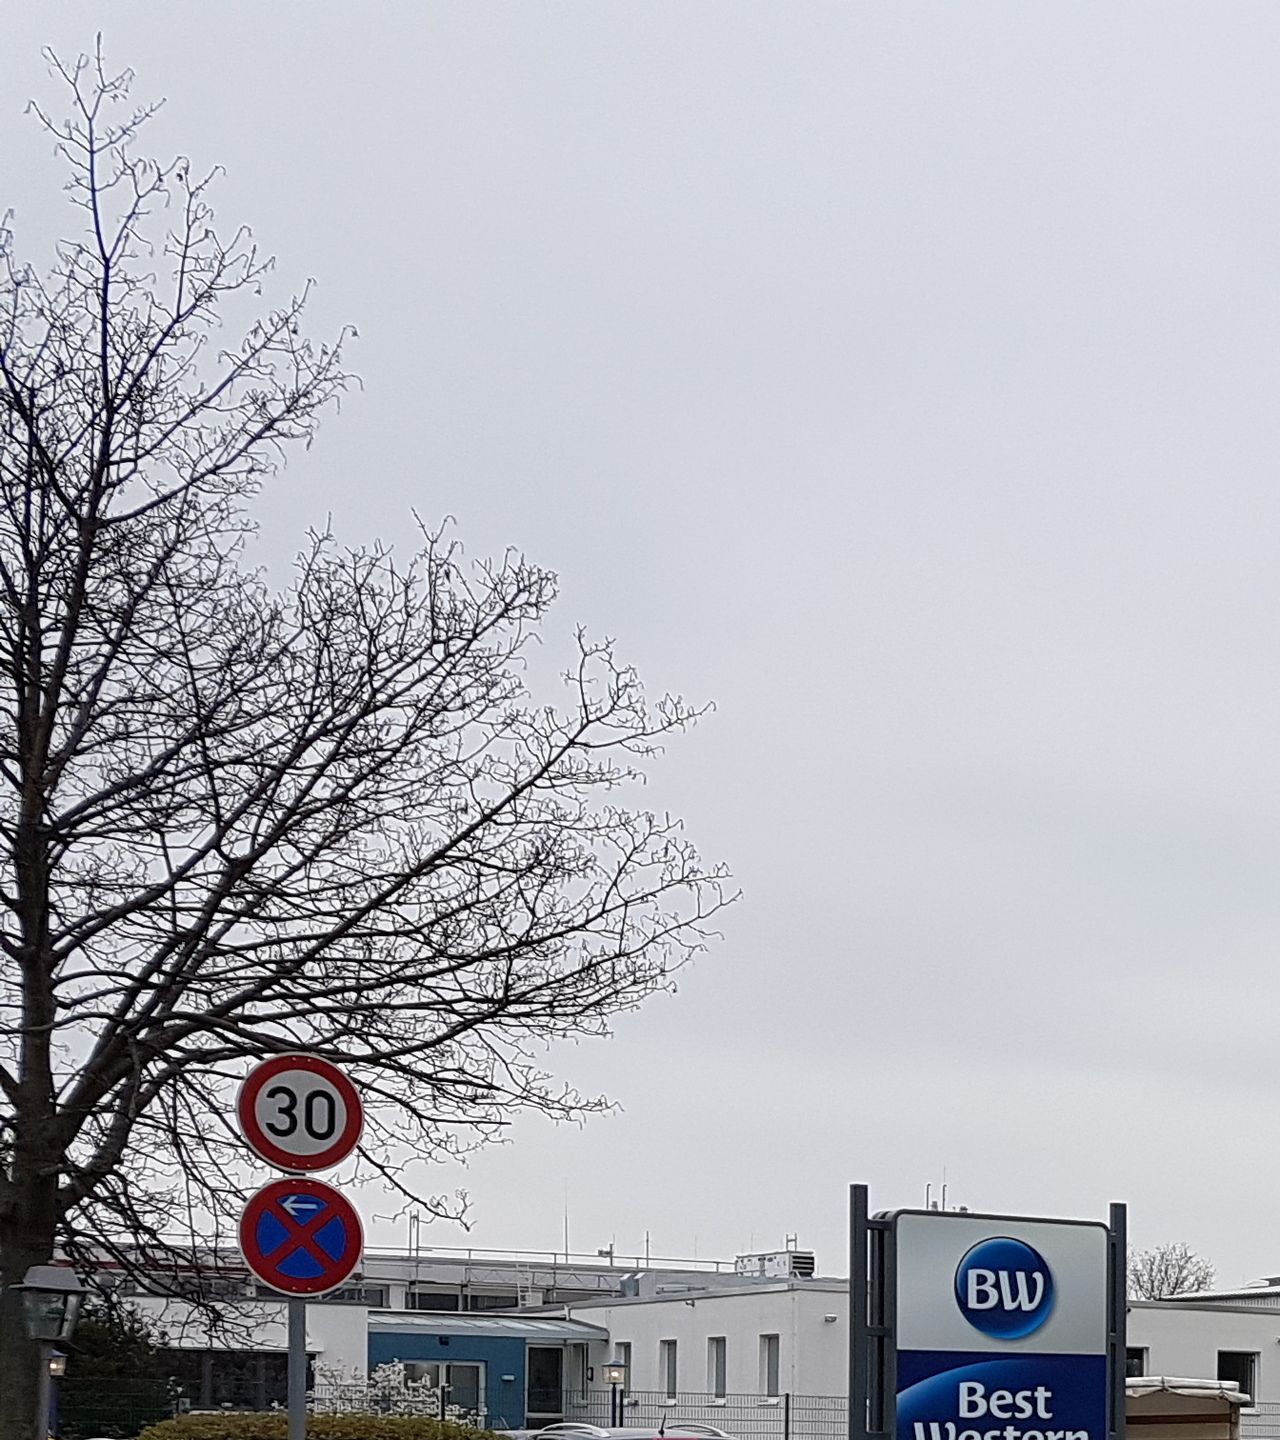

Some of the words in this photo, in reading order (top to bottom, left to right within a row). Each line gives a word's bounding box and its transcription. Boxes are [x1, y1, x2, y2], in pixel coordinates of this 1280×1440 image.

[266, 1086, 335, 1140] 30
[967, 1268, 1045, 1311] BW
[959, 1381, 1053, 1419] Best
